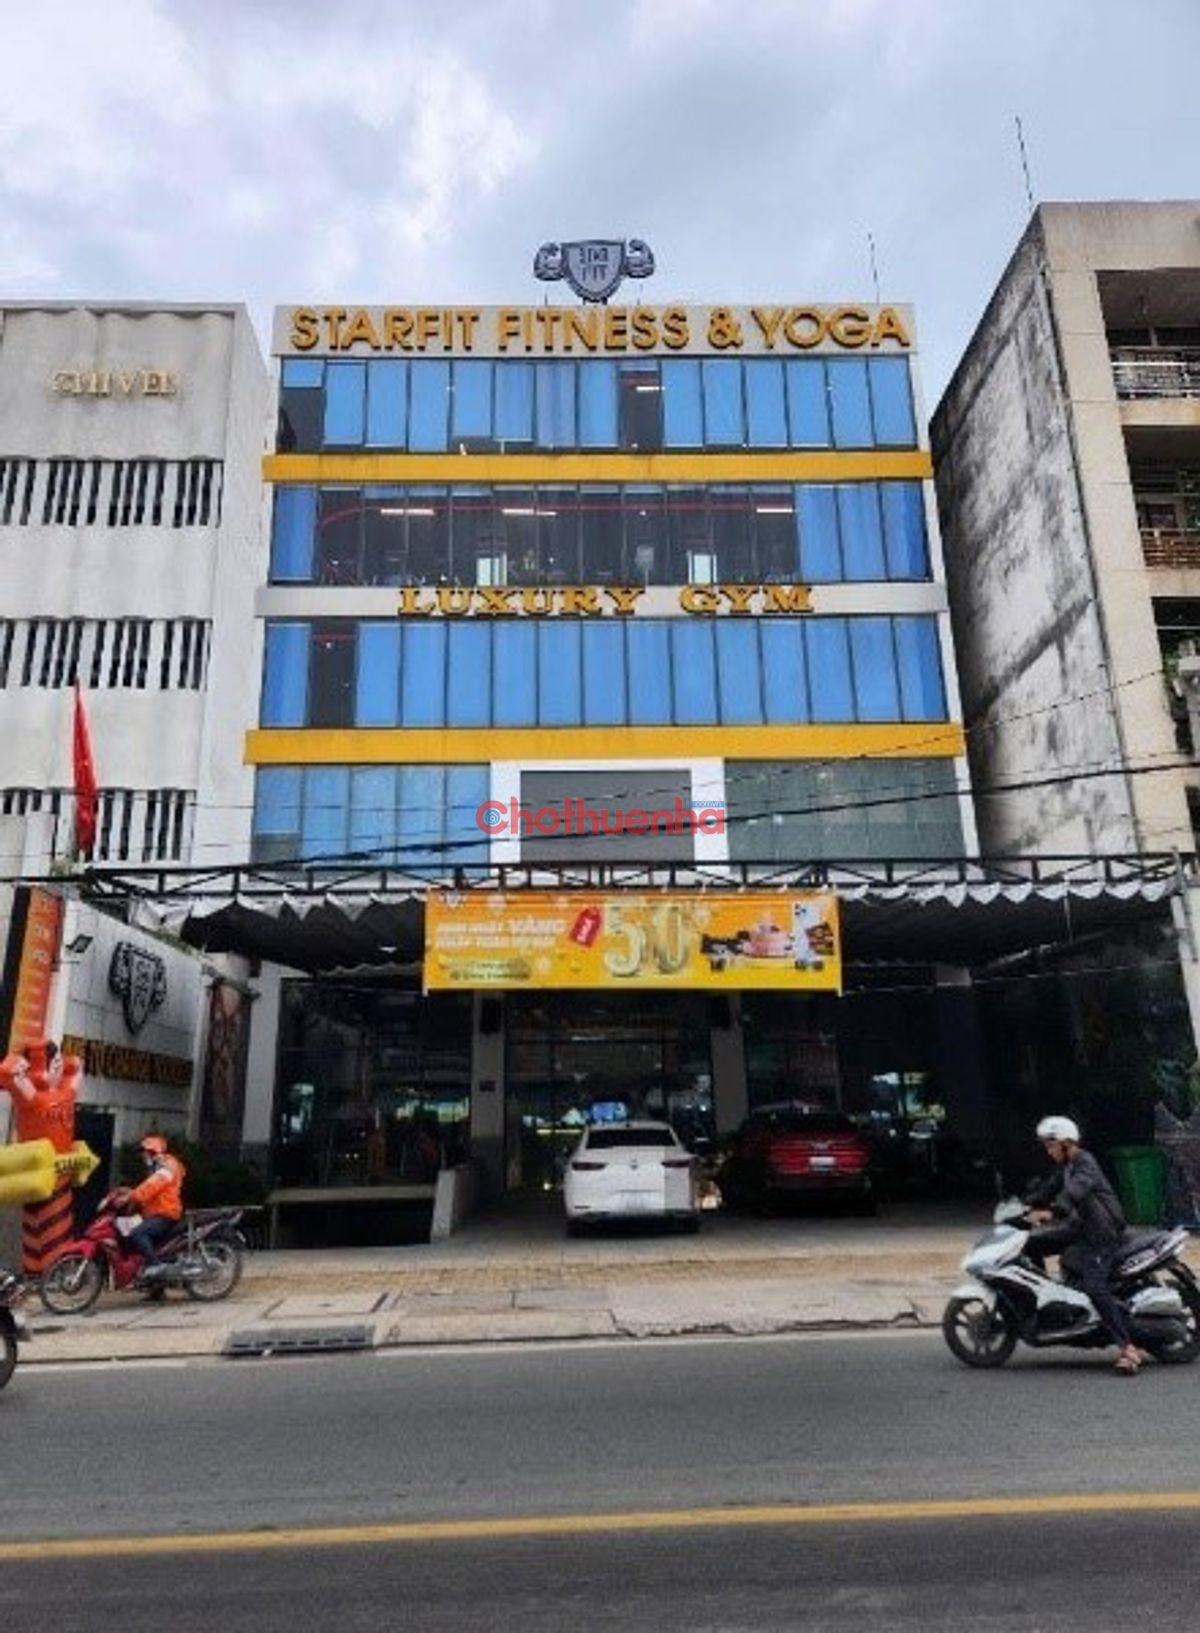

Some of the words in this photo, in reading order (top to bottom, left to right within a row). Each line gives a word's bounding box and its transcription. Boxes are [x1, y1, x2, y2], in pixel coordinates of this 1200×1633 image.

[290, 306, 480, 351] STARFIT
[497, 304, 690, 351] FITNESS
[707, 304, 744, 349] &
[751, 304, 911, 348] YOGA
[398, 585, 645, 617] LUXURY
[679, 584, 813, 614] GYM
